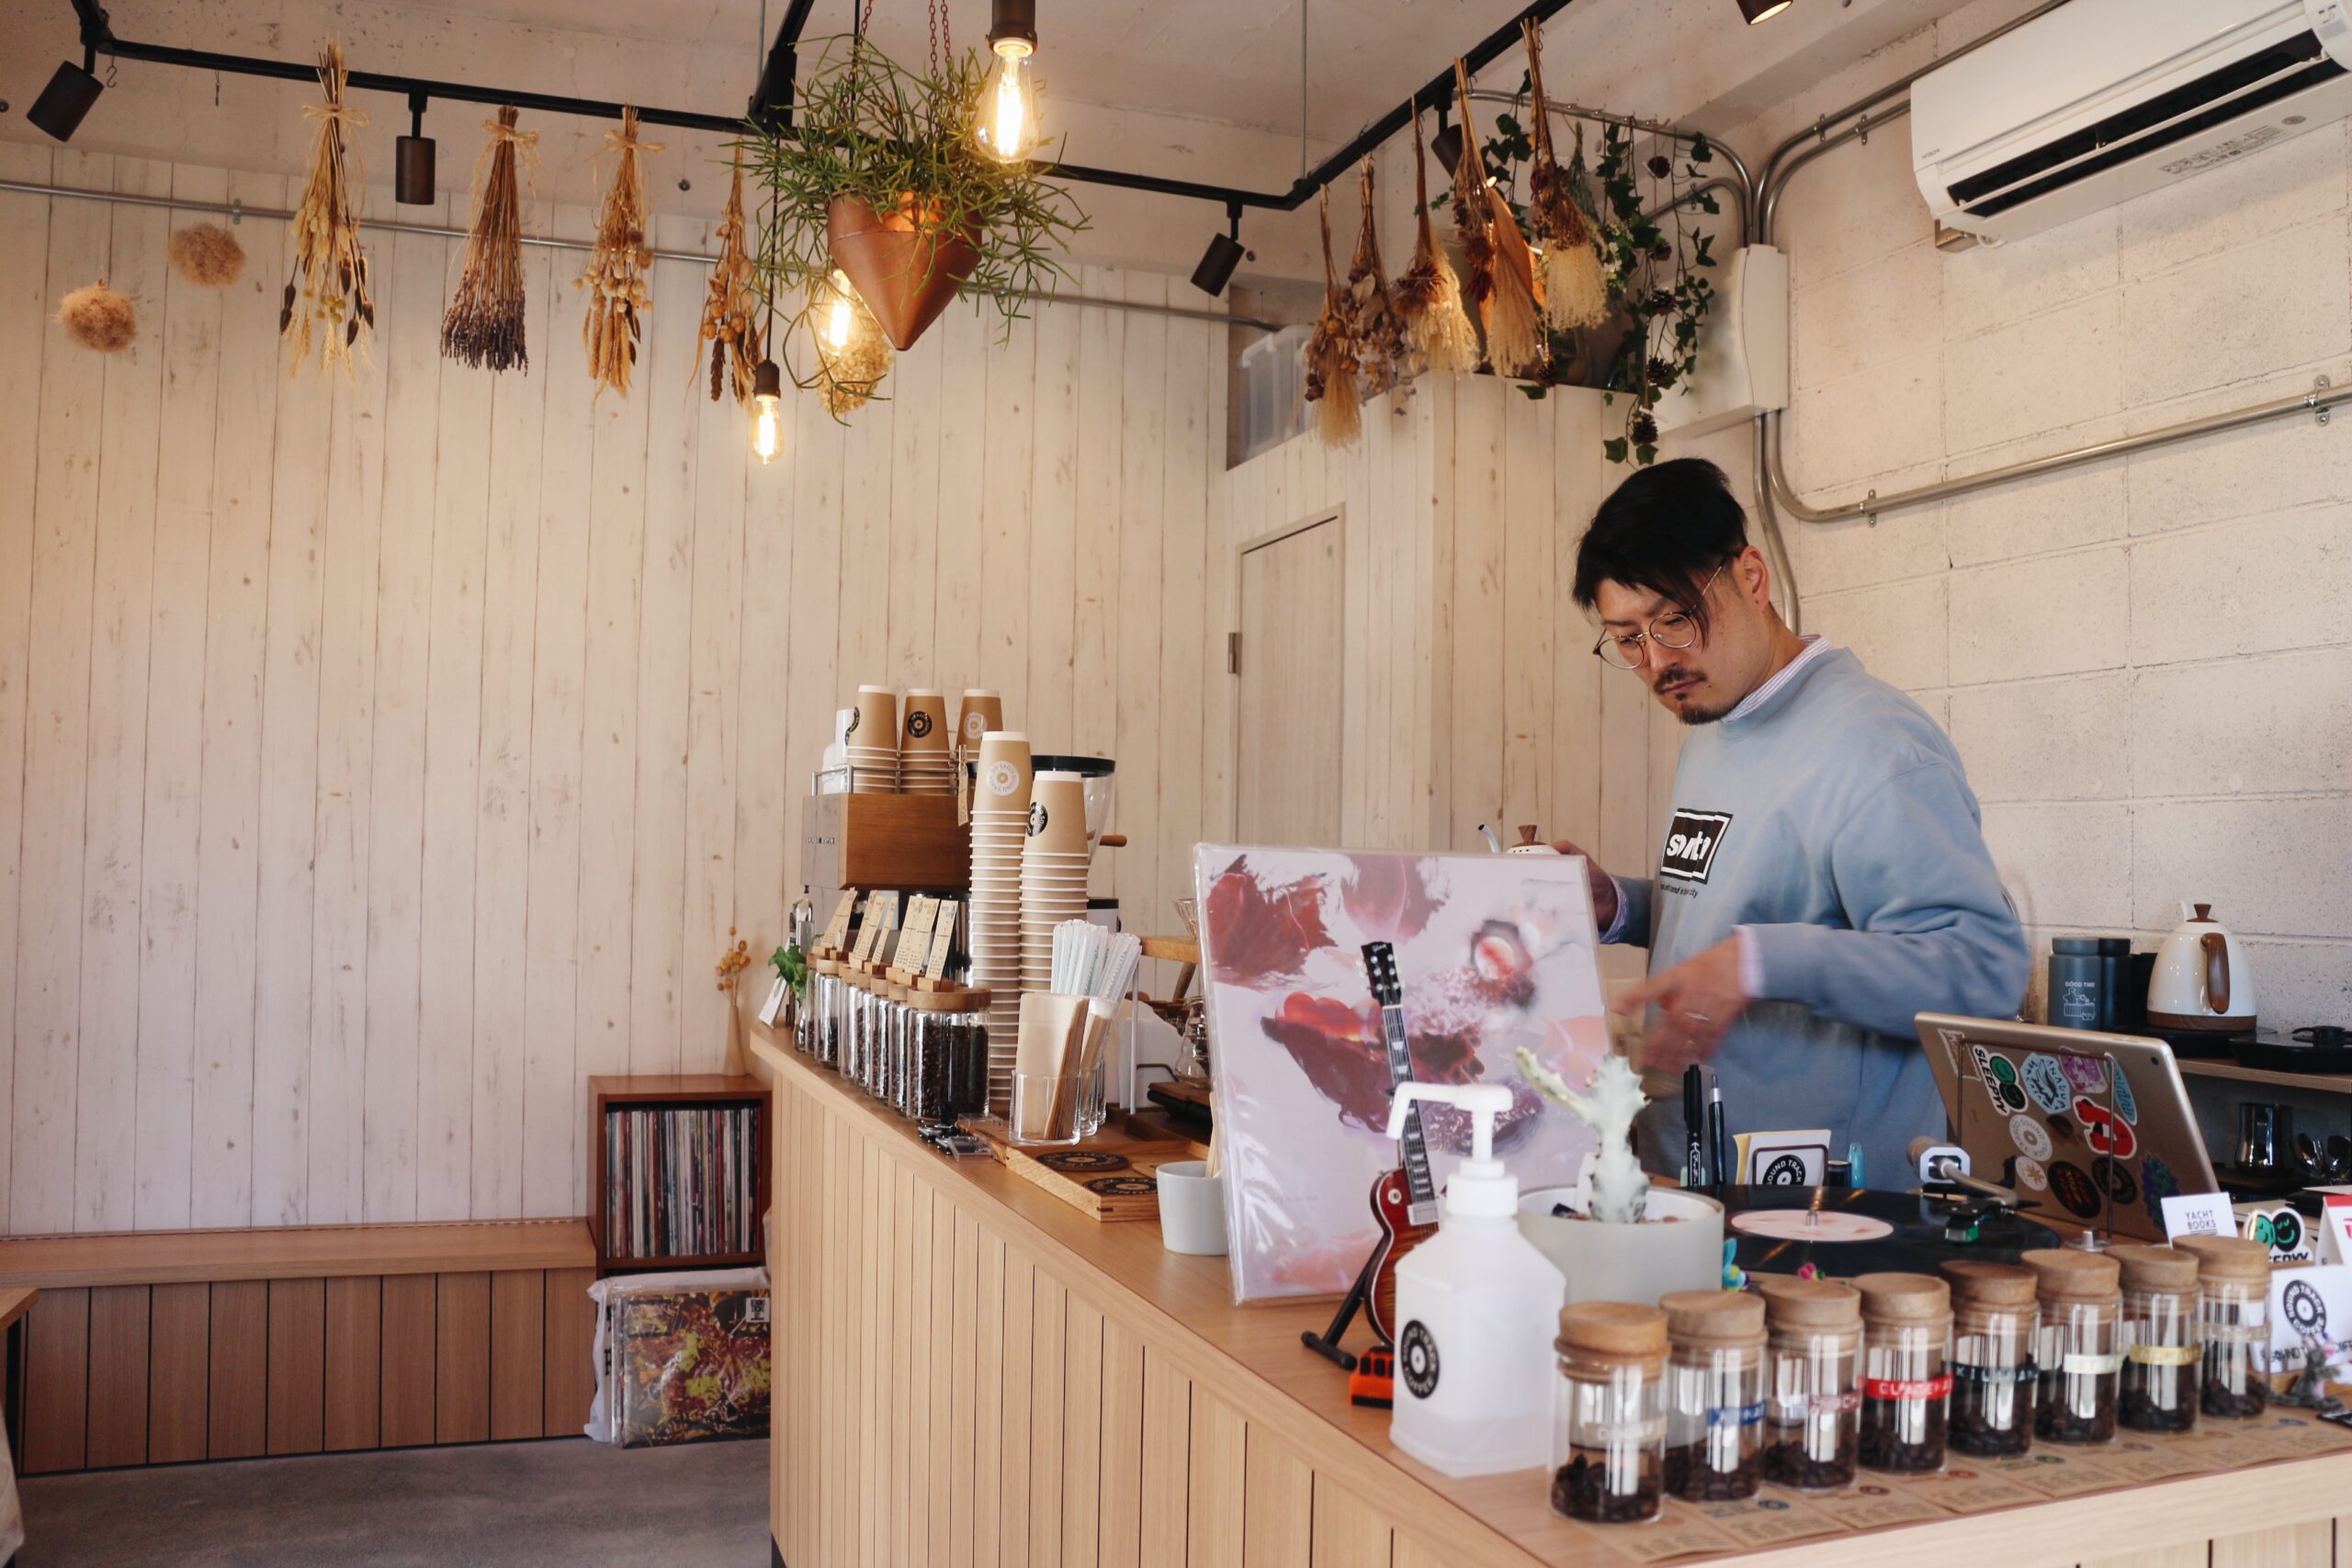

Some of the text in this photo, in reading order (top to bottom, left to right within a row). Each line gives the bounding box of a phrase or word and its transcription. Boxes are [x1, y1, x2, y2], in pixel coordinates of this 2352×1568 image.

[1787, 1159, 1803, 1183] TRACK
[2185, 1210, 2213, 1221] YACHT
[2188, 1220, 2216, 1230] BOOKS
[2300, 1284, 2324, 1314] TRACK
